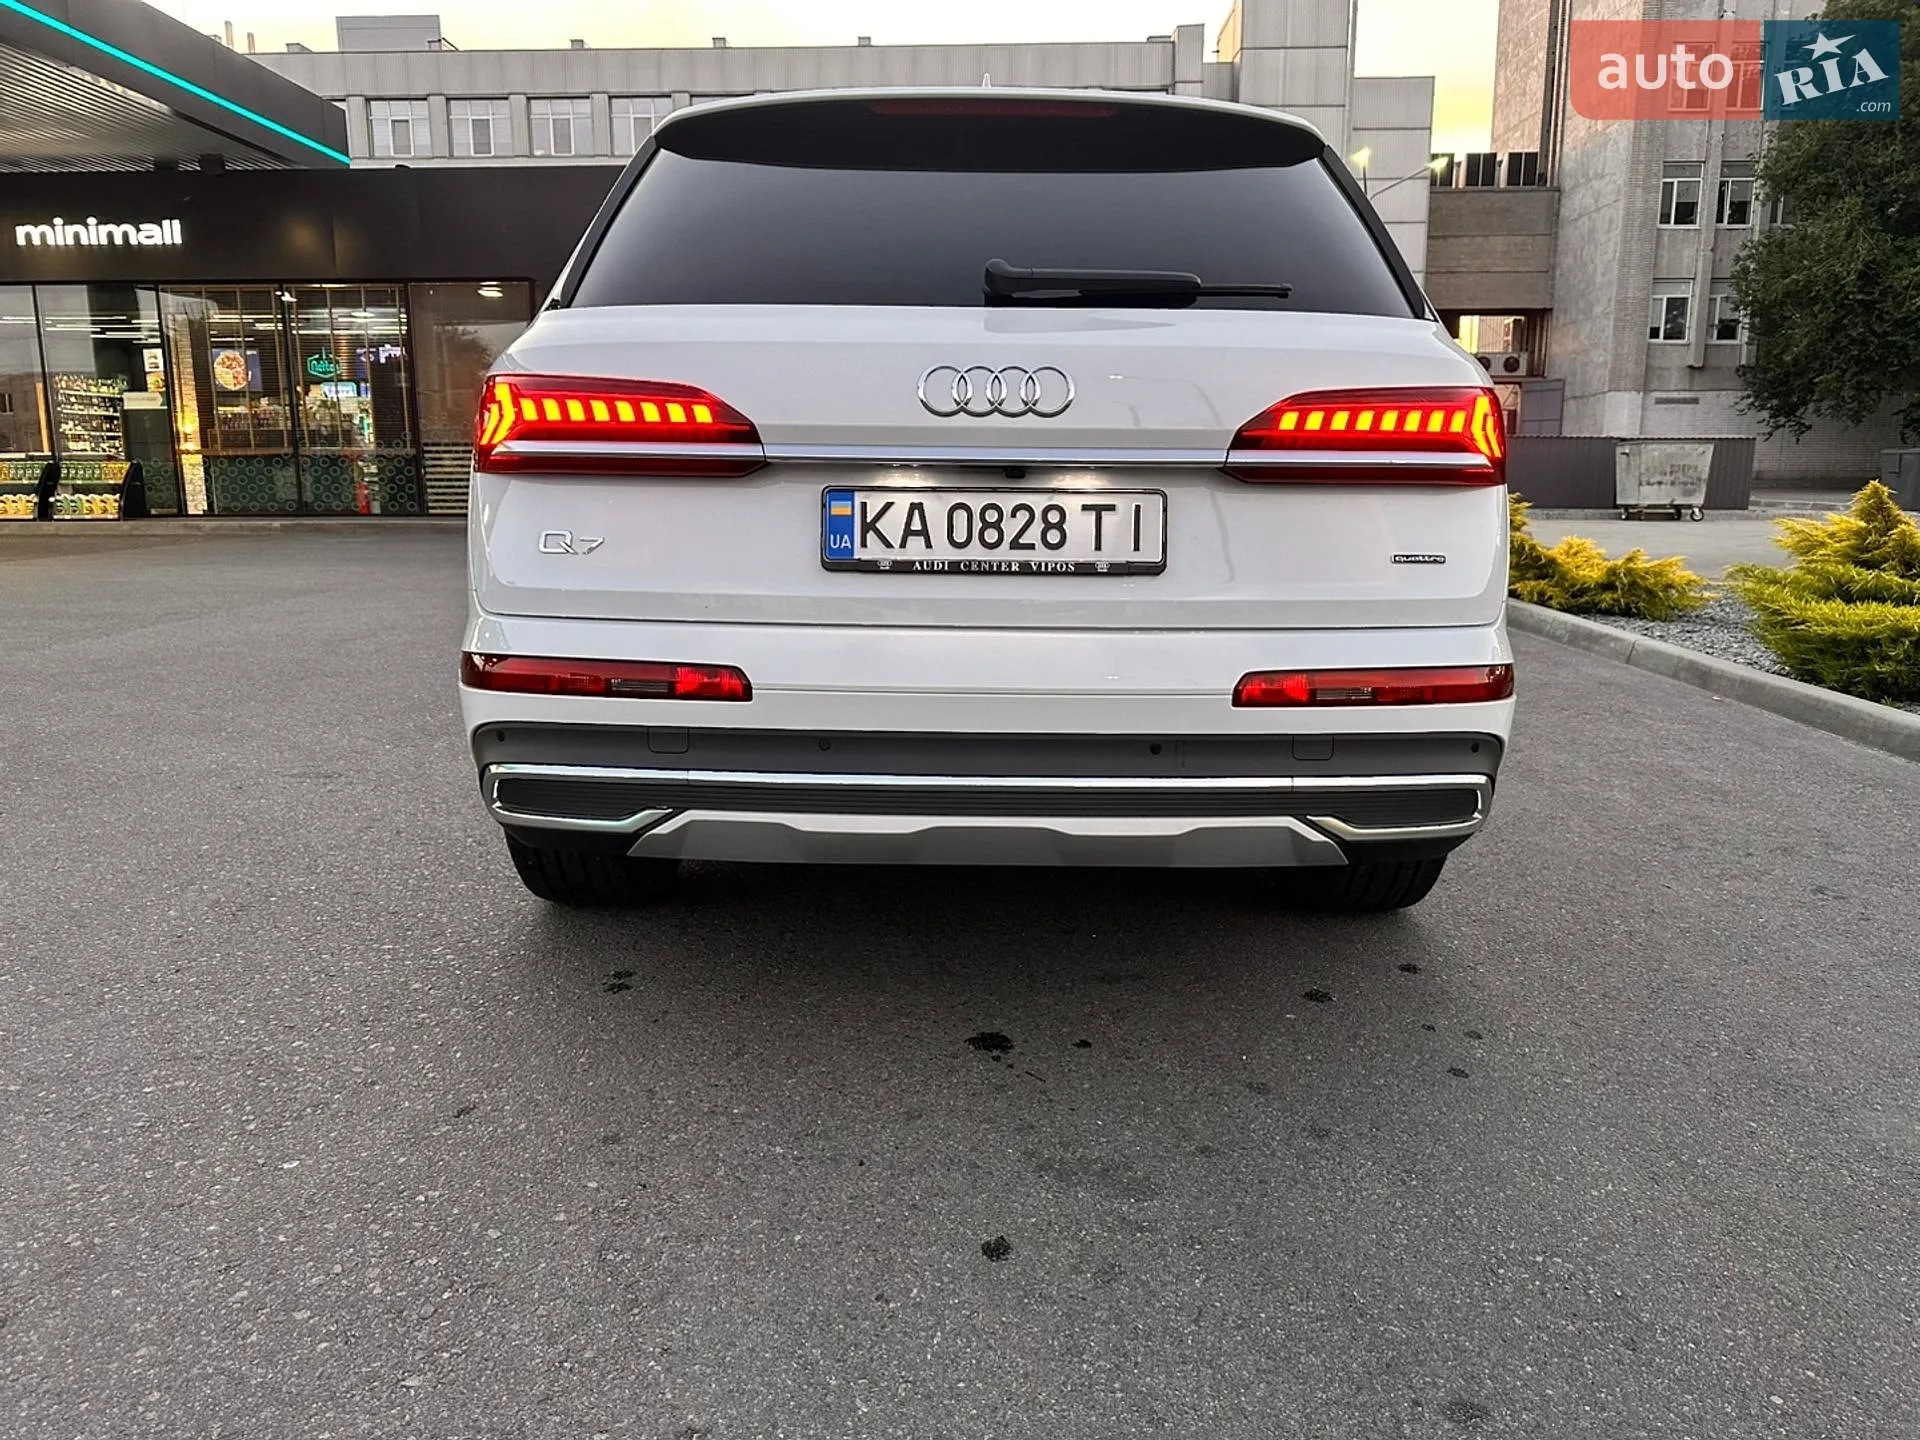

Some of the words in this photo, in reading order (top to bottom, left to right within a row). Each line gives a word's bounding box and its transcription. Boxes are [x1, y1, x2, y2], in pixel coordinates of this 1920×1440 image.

[15, 216, 182, 246] minimall
[859, 501, 934, 550] KA
[946, 502, 1068, 551] 0828
[1080, 503, 1142, 552] TI
[538, 530, 605, 555] Q7
[829, 534, 852, 549] UA
[911, 560, 949, 571] AUDI
[959, 561, 1020, 572] CENTER
[1029, 561, 1076, 572] VIPOS
[1394, 554, 1445, 564] quattro
